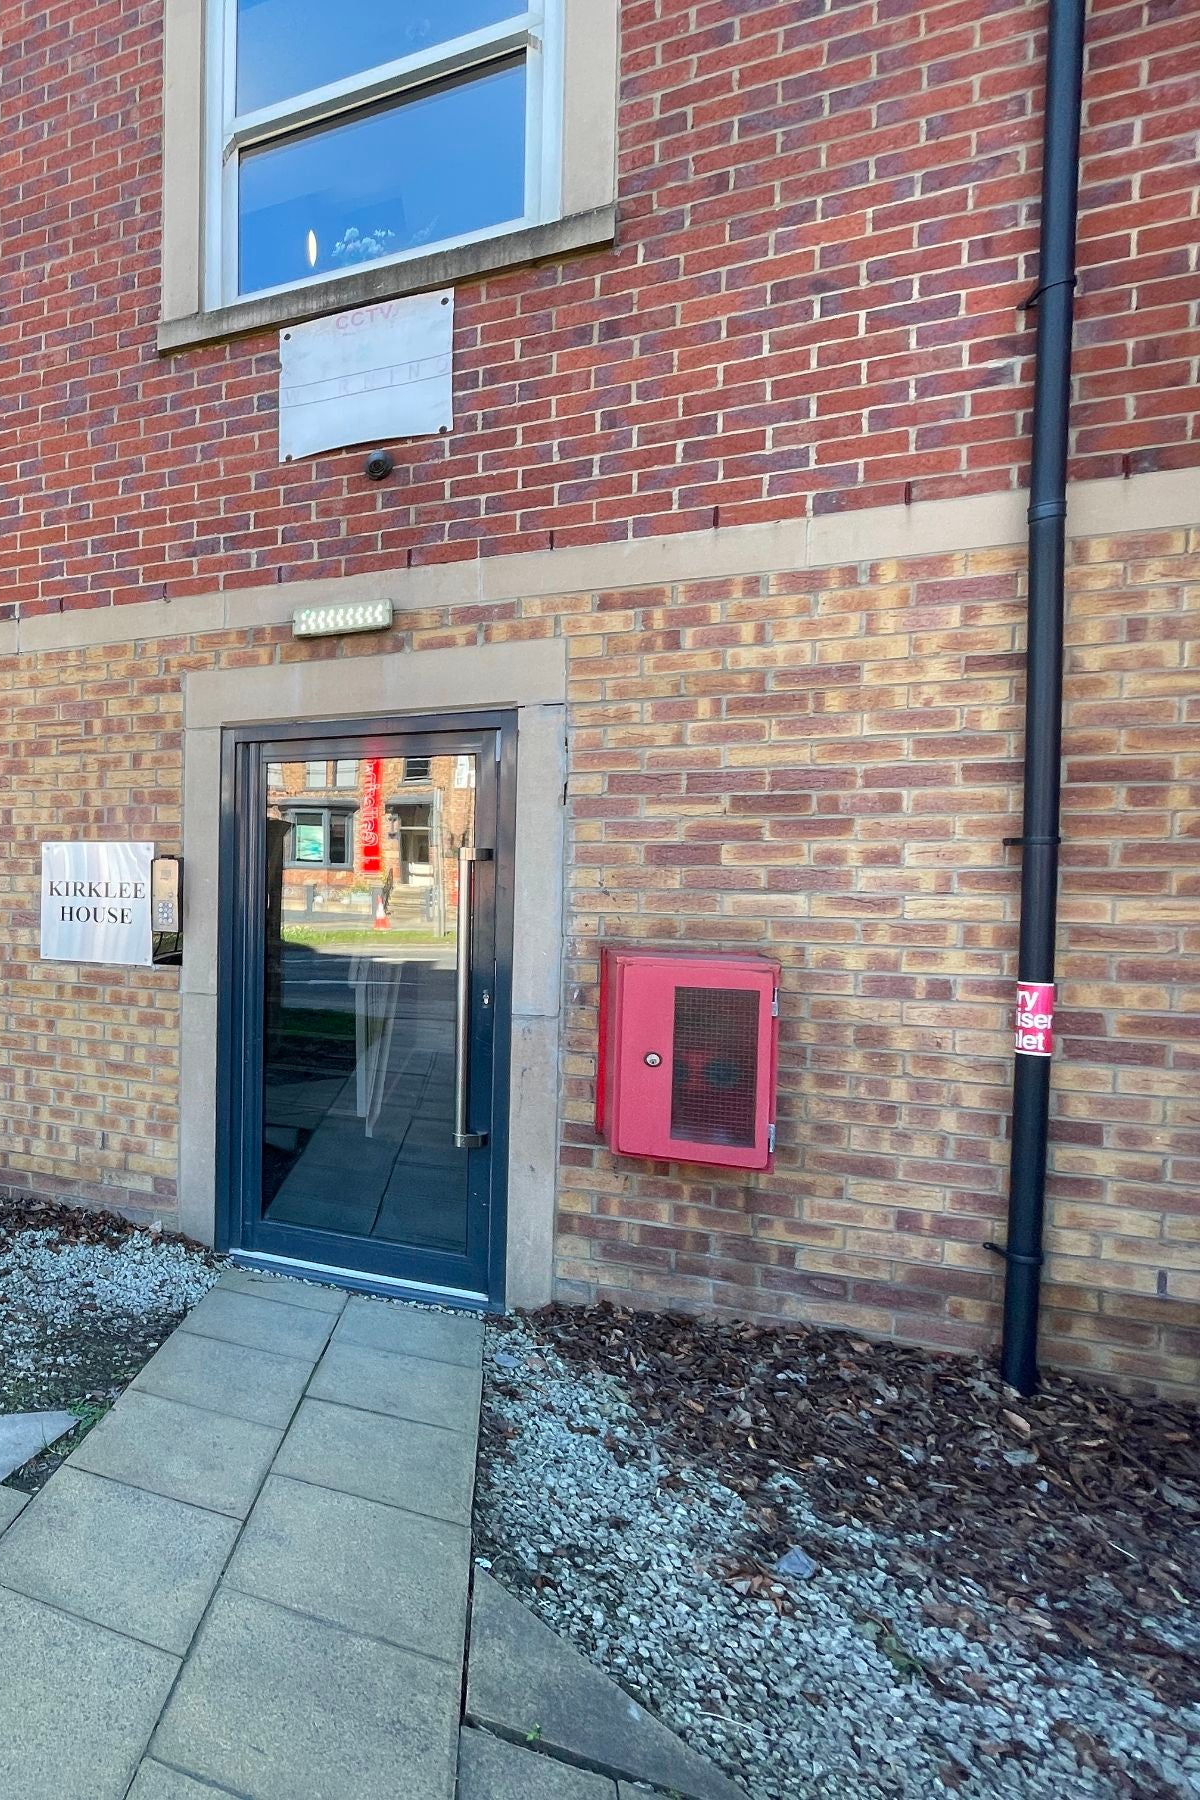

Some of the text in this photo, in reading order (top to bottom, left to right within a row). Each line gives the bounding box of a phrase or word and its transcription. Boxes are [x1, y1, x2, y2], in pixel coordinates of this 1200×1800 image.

[335, 304, 394, 331] CCTV
[48, 880, 146, 899] KIRKLEE
[60, 905, 133, 925] HOUSE
